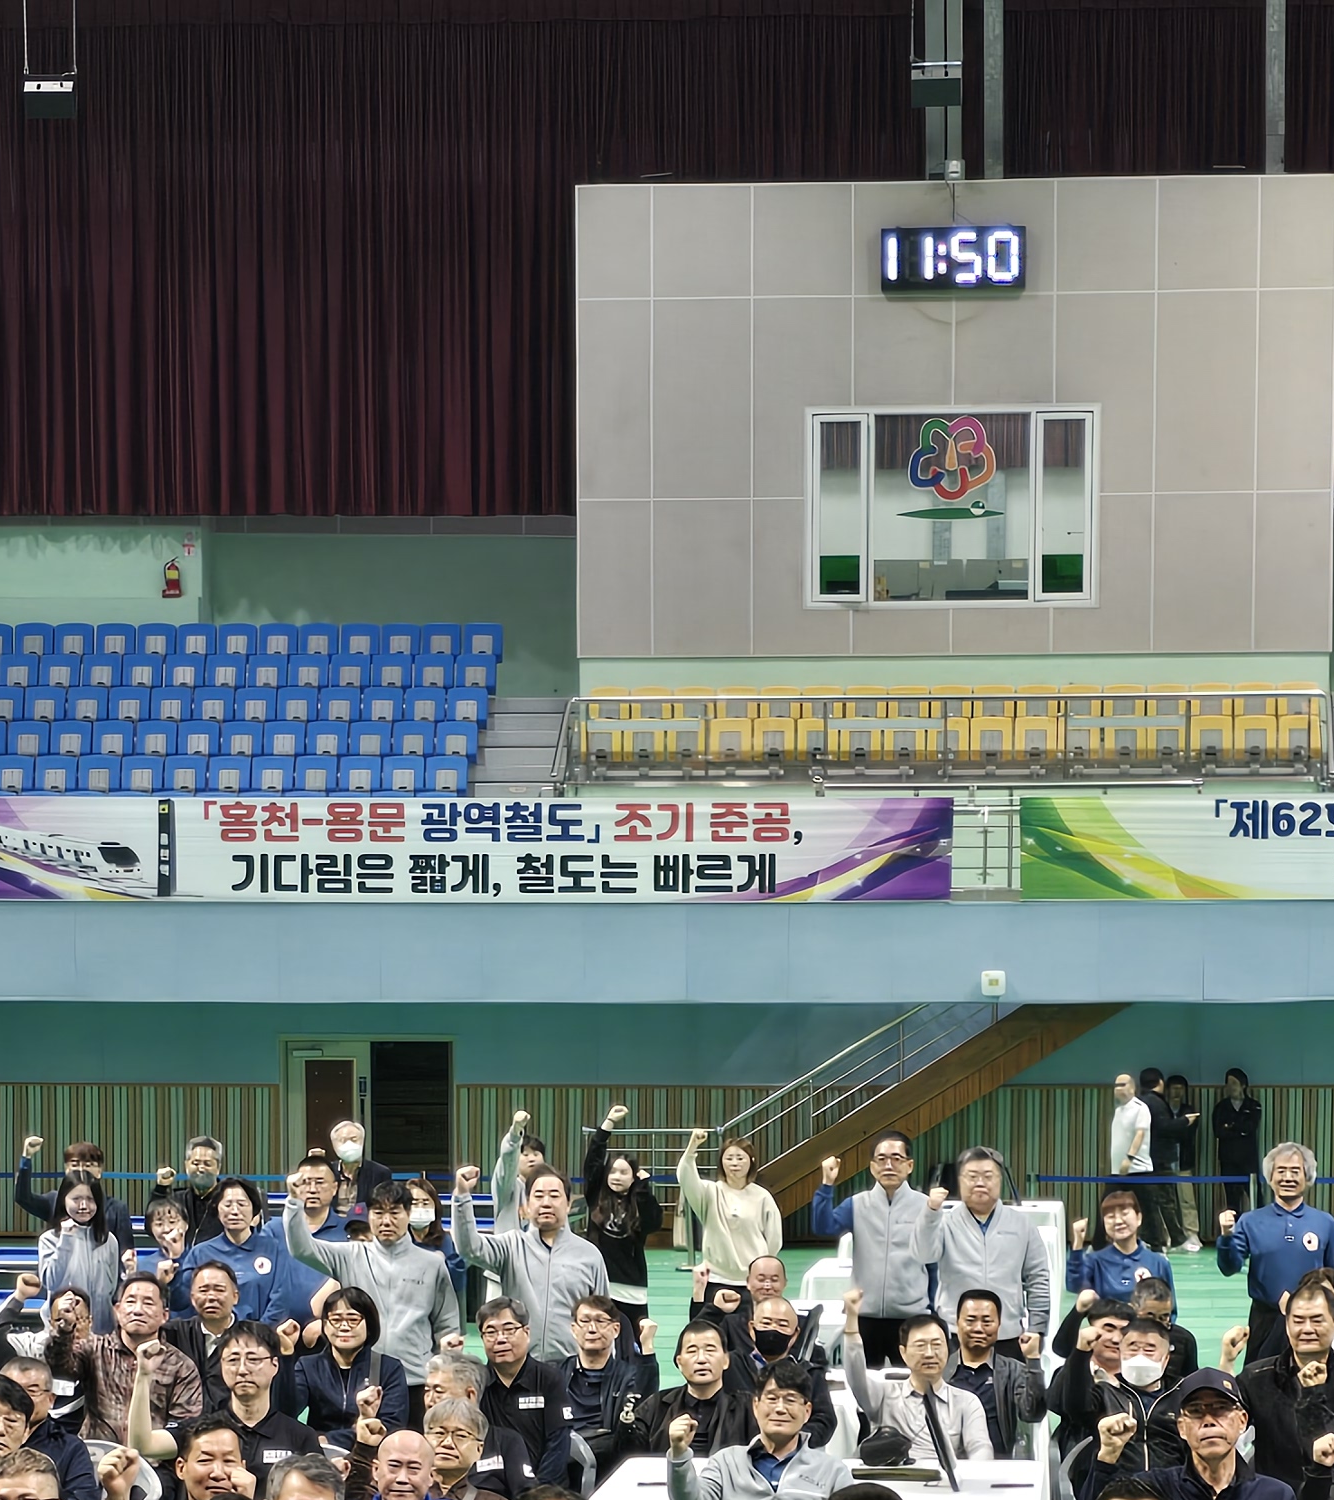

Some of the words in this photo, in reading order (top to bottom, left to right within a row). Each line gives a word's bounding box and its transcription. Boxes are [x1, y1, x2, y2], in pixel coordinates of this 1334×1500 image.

[886, 231, 1020, 284] 11:50
[613, 802, 695, 843] 조기
[709, 802, 803, 846] 준공,
[231, 853, 394, 895] 기다림은
[409, 853, 502, 897] 짧게,
[516, 853, 639, 894] 철도는
[653, 853, 777, 894] 빠르게
